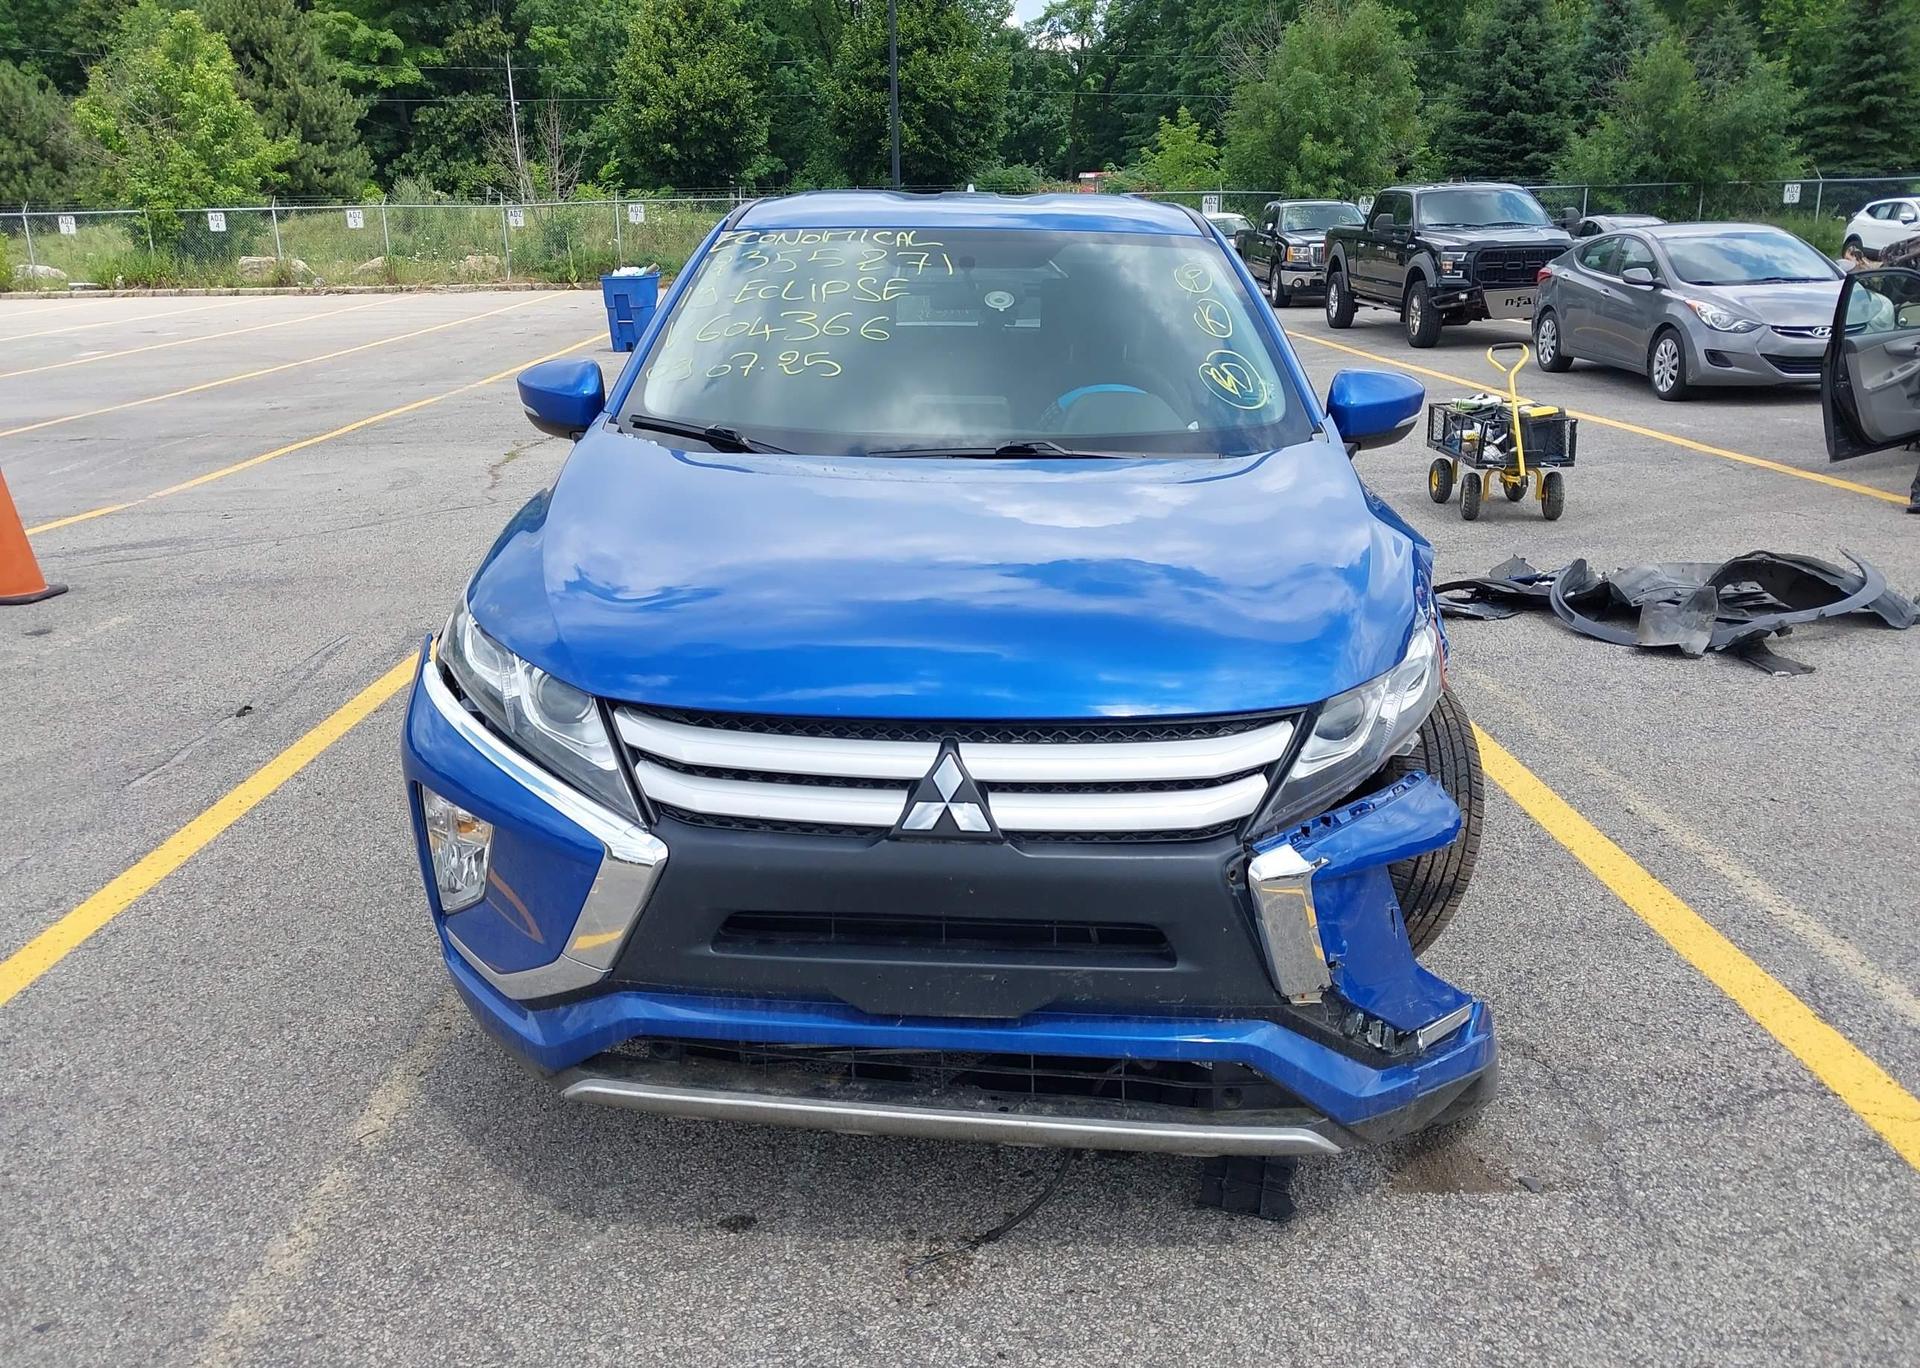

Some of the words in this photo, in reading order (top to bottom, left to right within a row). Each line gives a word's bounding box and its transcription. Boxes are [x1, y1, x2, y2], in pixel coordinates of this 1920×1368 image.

[1786, 185, 1799, 193] ADZ
[1204, 197, 1217, 205] ADZ
[1788, 193, 1796, 201] 15
[630, 205, 643, 213] ADZ
[210, 214, 223, 222] ADZ
[348, 211, 362, 219] ADZ
[510, 210, 522, 218] ADZ
[634, 213, 639, 221] 7
[60, 216, 73, 225] ADZ
[353, 219, 358, 227] 5
[65, 224, 71, 233] 3
